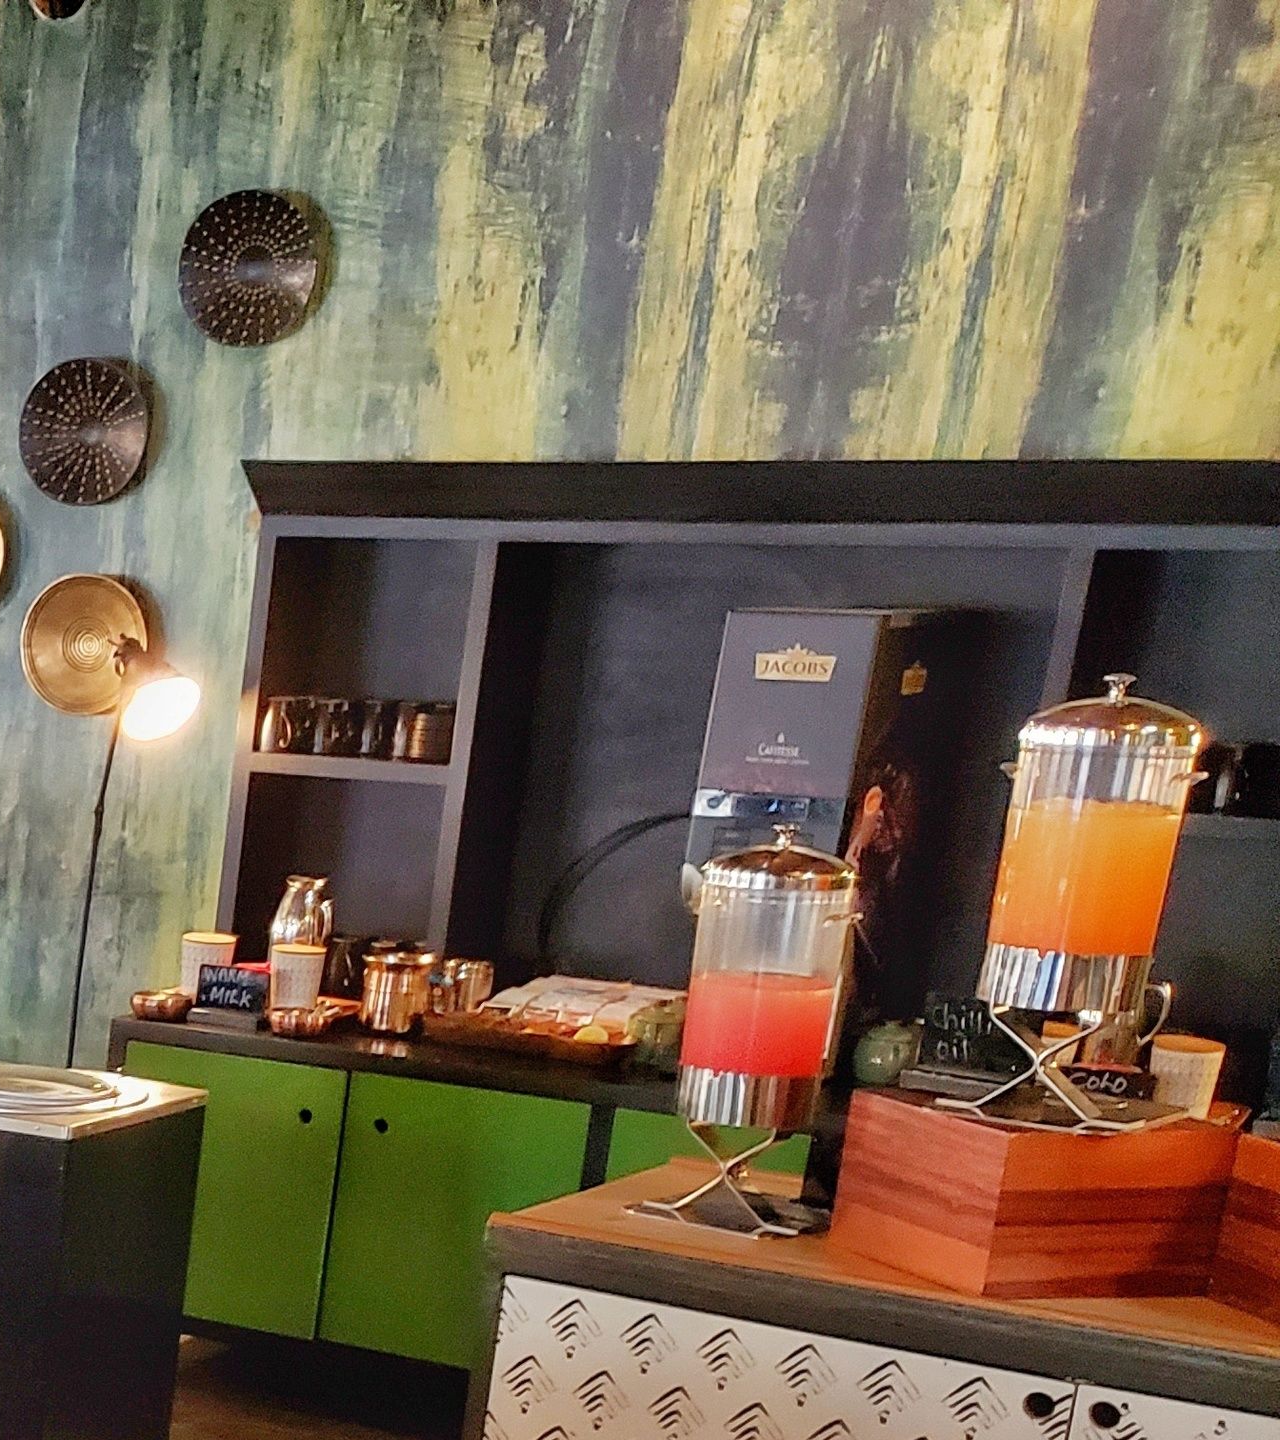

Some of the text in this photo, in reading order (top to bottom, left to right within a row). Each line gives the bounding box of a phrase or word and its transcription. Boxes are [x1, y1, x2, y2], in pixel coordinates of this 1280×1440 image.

[761, 660, 830, 676] JACOBS
[202, 967, 250, 986] WARM
[209, 986, 252, 1008] MILK
